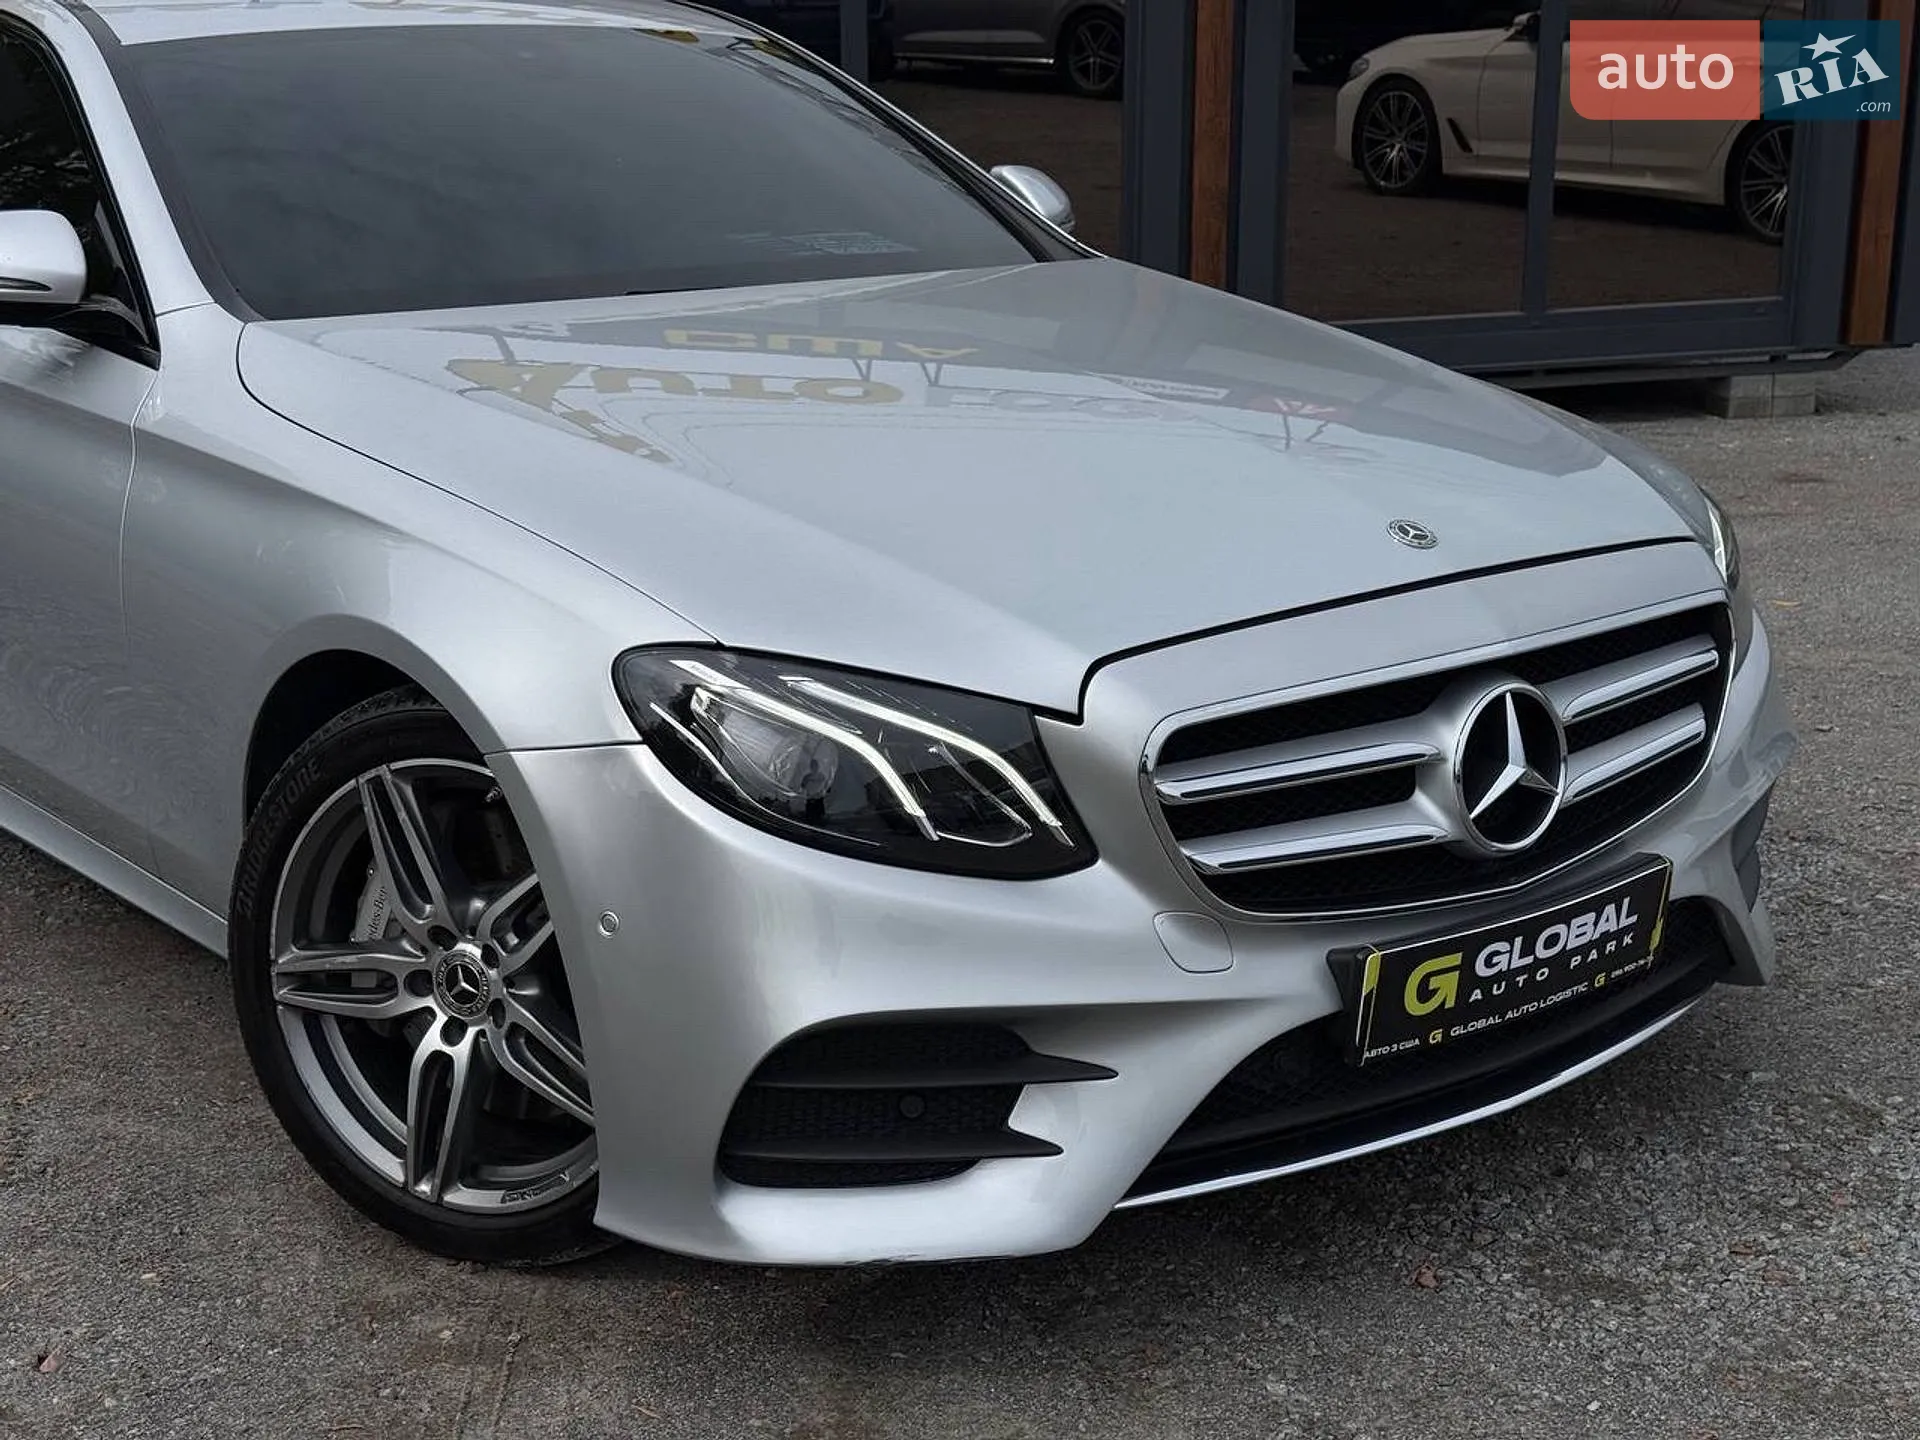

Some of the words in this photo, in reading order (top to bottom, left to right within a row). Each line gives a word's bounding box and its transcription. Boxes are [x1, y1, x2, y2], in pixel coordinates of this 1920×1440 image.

[1468, 968, 1550, 1003] AUTO
[1570, 931, 1634, 969] PARK
[1475, 897, 1637, 976] GLOBAL
[1404, 952, 1464, 1017] G
[1450, 1014, 1503, 1037] GLOBAL
[1504, 1002, 1539, 1022] AUTO
[1538, 981, 1589, 1016] LOGISTIC
